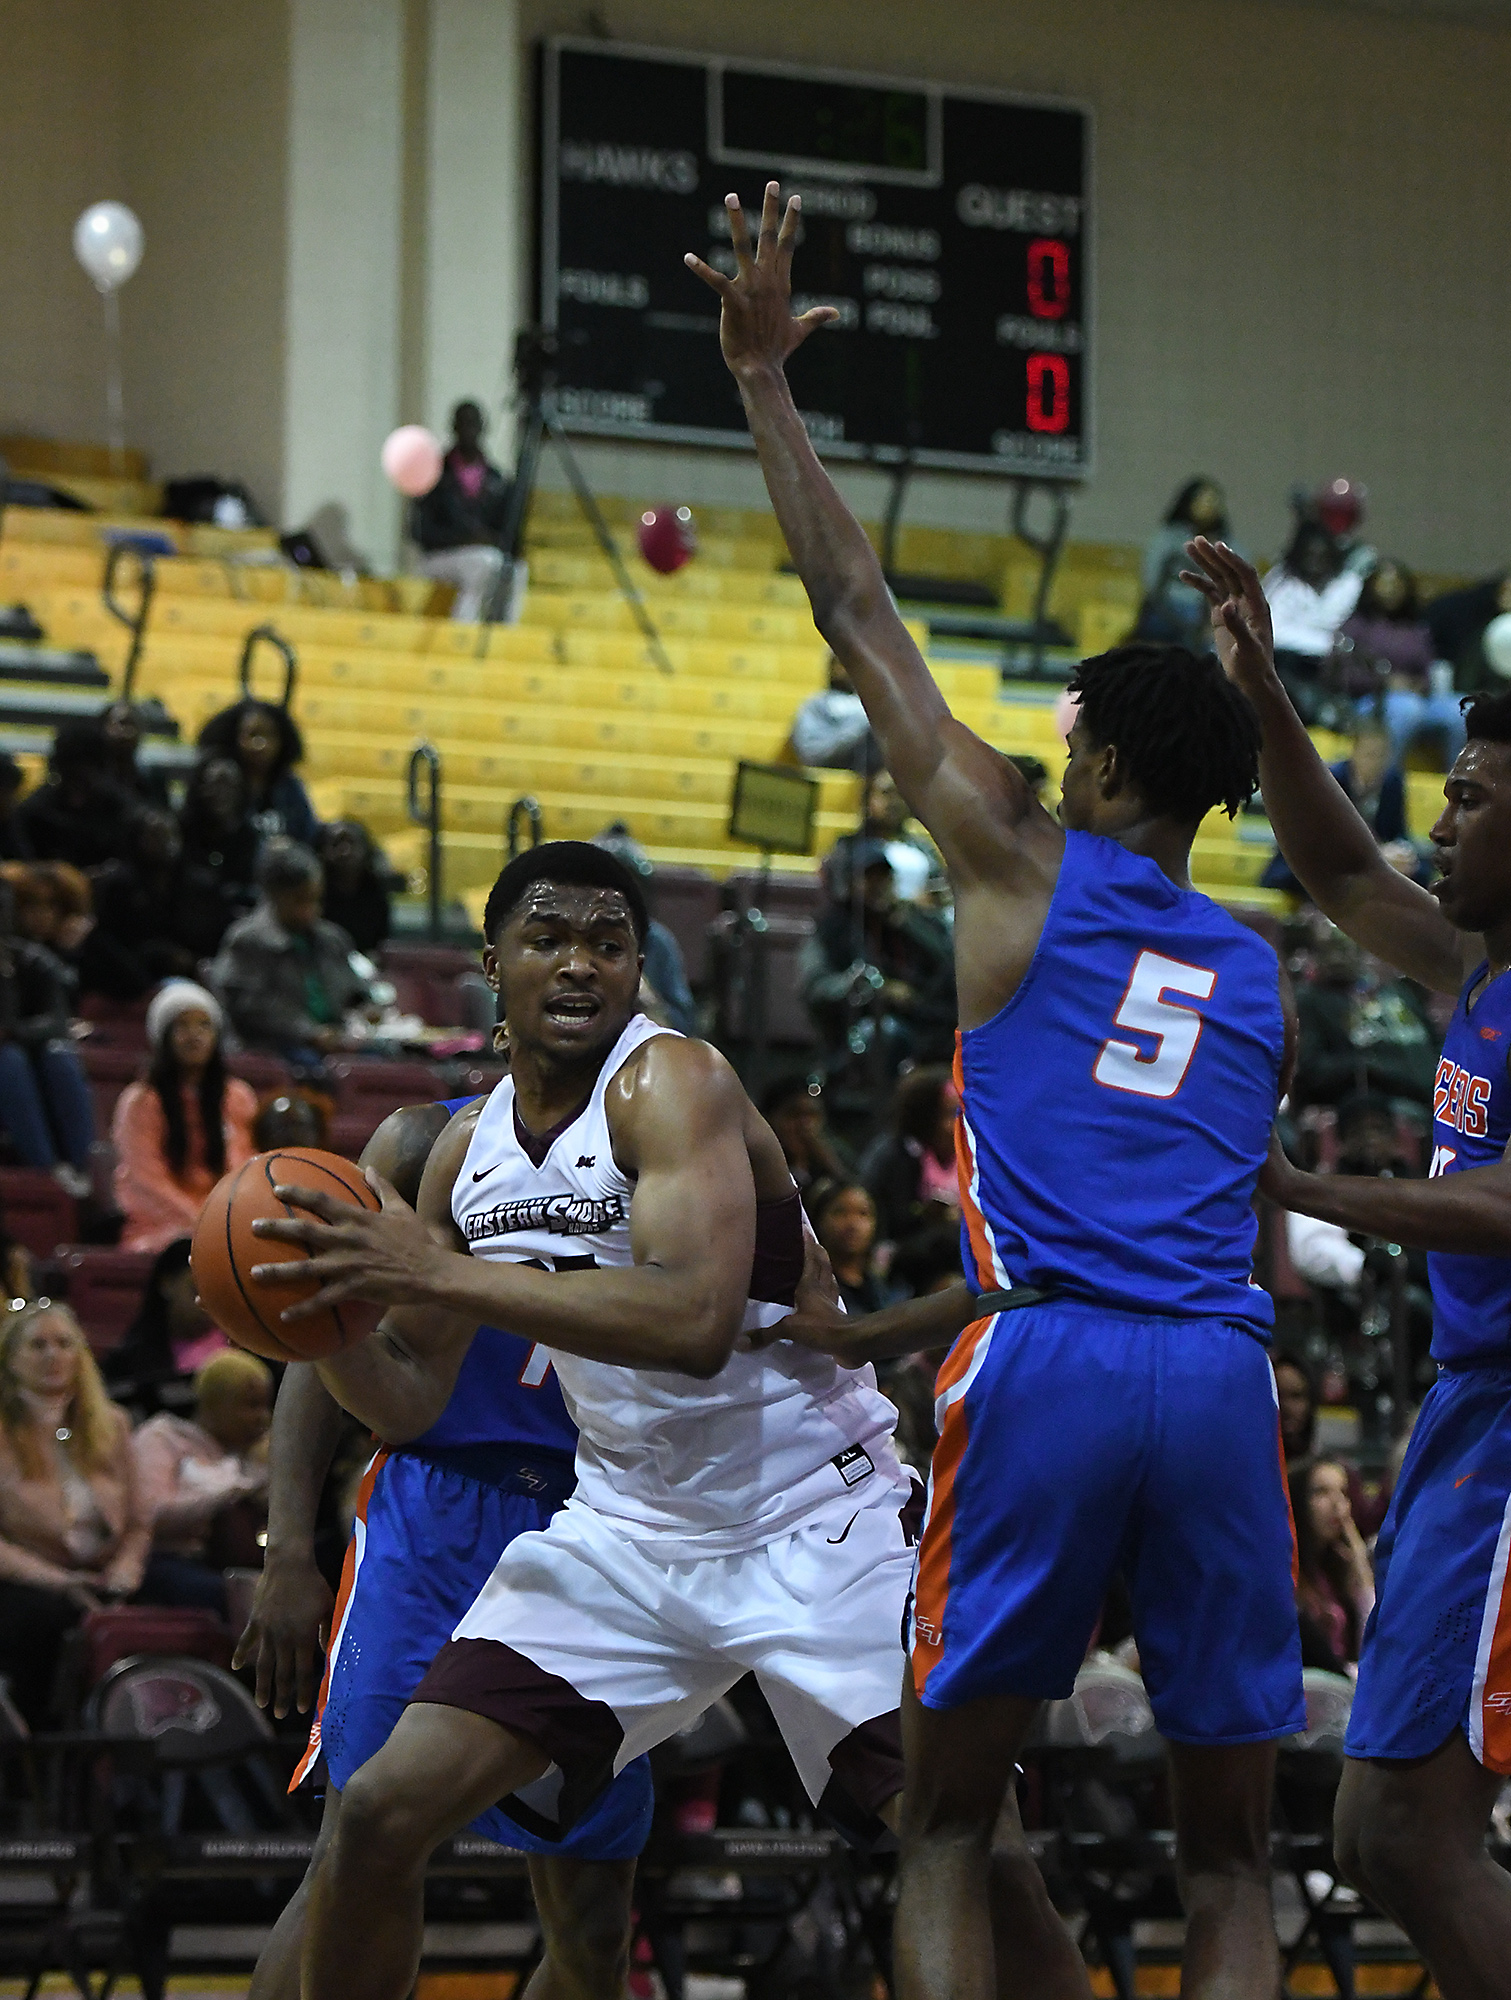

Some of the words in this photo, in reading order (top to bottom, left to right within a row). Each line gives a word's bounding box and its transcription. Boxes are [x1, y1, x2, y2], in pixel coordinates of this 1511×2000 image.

[957, 182, 1081, 236] GUEST
[1027, 238, 1071, 320] 0
[1026, 353, 1071, 435] 0
[1092, 947, 1218, 1100] 5
[465, 1204, 546, 1240] EASTERN
[546, 1196, 622, 1231] SHORE
